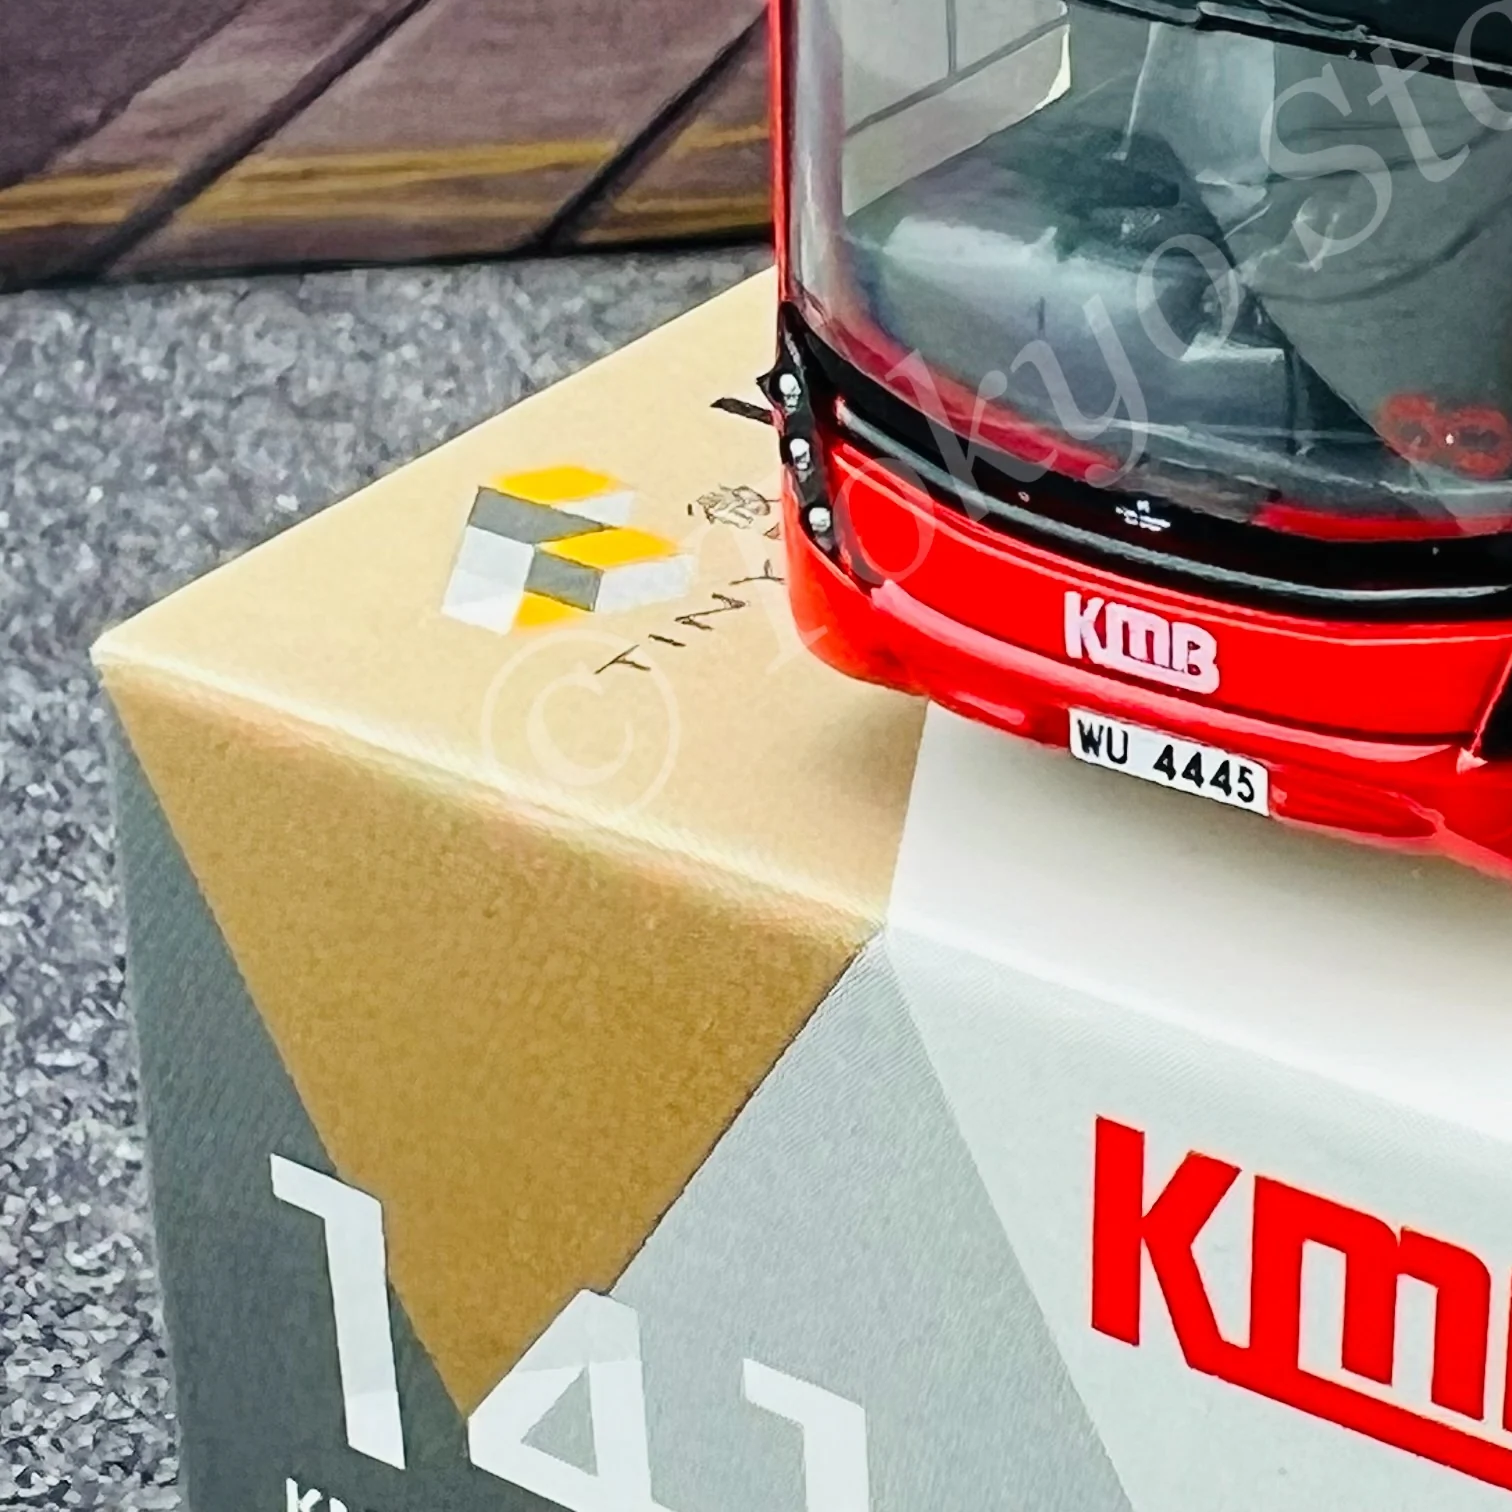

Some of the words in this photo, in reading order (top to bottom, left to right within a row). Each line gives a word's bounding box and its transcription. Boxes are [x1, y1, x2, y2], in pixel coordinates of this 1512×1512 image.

[593, 558, 787, 676] TINY
[1078, 719, 1128, 765] WU
[1153, 744, 1255, 803] 4445
